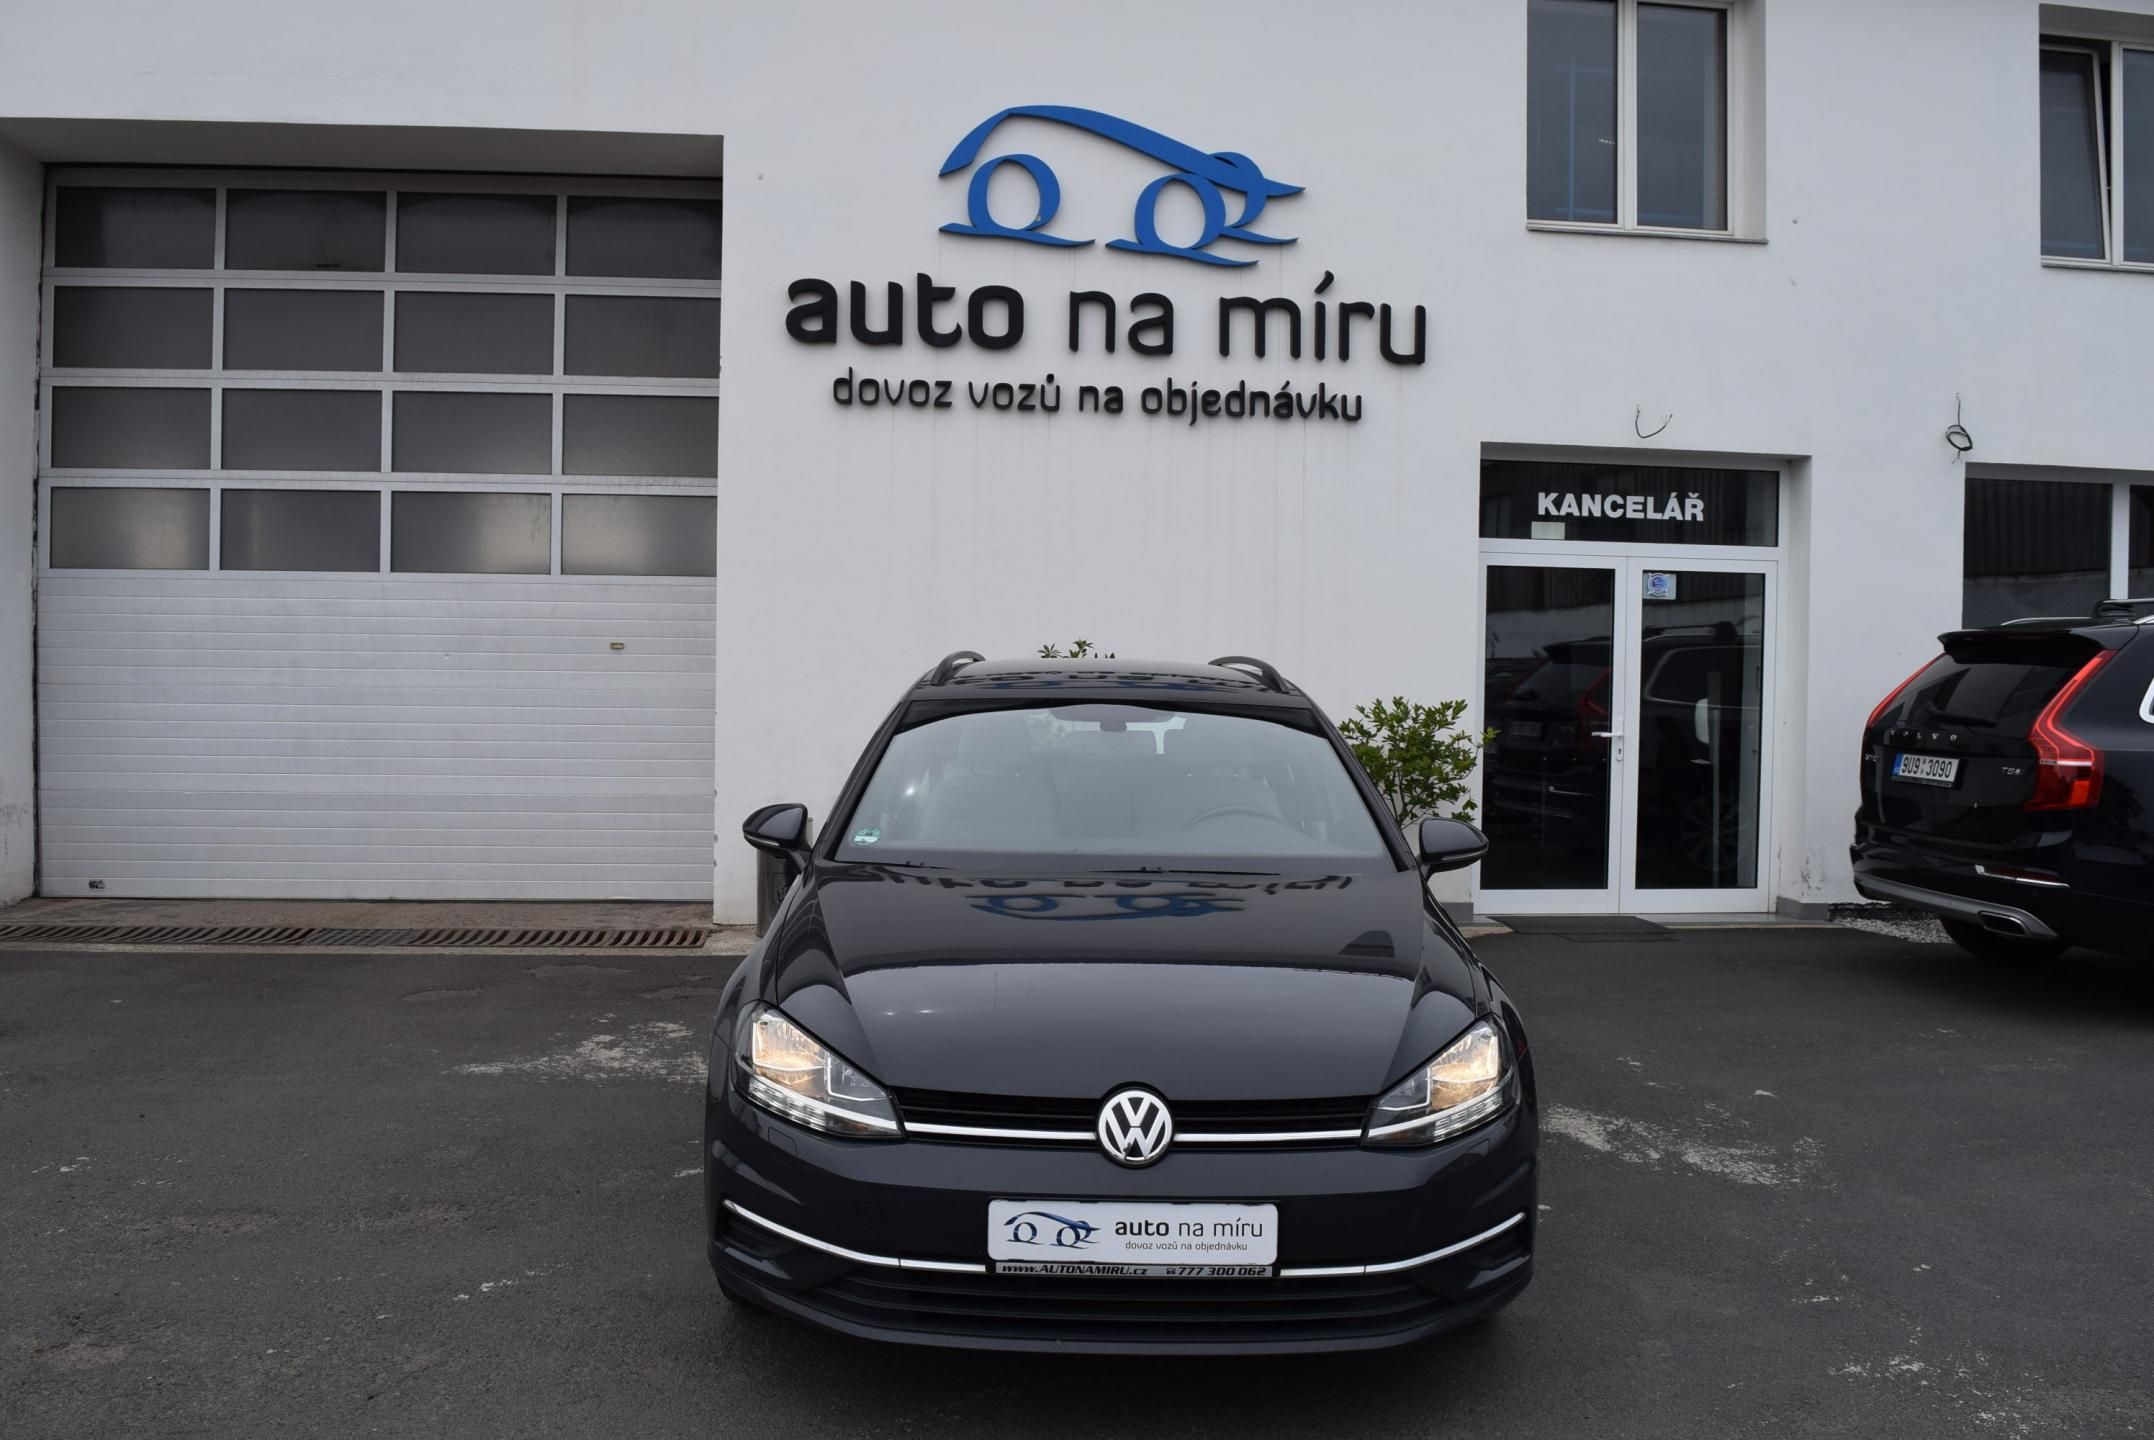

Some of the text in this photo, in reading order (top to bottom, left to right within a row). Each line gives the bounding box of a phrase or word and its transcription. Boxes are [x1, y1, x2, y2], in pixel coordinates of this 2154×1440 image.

[785, 270, 1427, 367] auto na míru
[832, 366, 1363, 425] dovoz vozů na objednávku
[1537, 492, 1704, 522] KANCELÁŘ
[1890, 730, 1957, 741] VOLVO
[1902, 756, 1921, 775] 9U9
[1925, 759, 1953, 779] 3090
[1114, 1216, 1263, 1238] auto na míru
[1125, 1240, 1248, 1253] dovoz vozů na objednávku
[1001, 1263, 1267, 1276] www.AUTONAMIRU.cz 777 300 062
